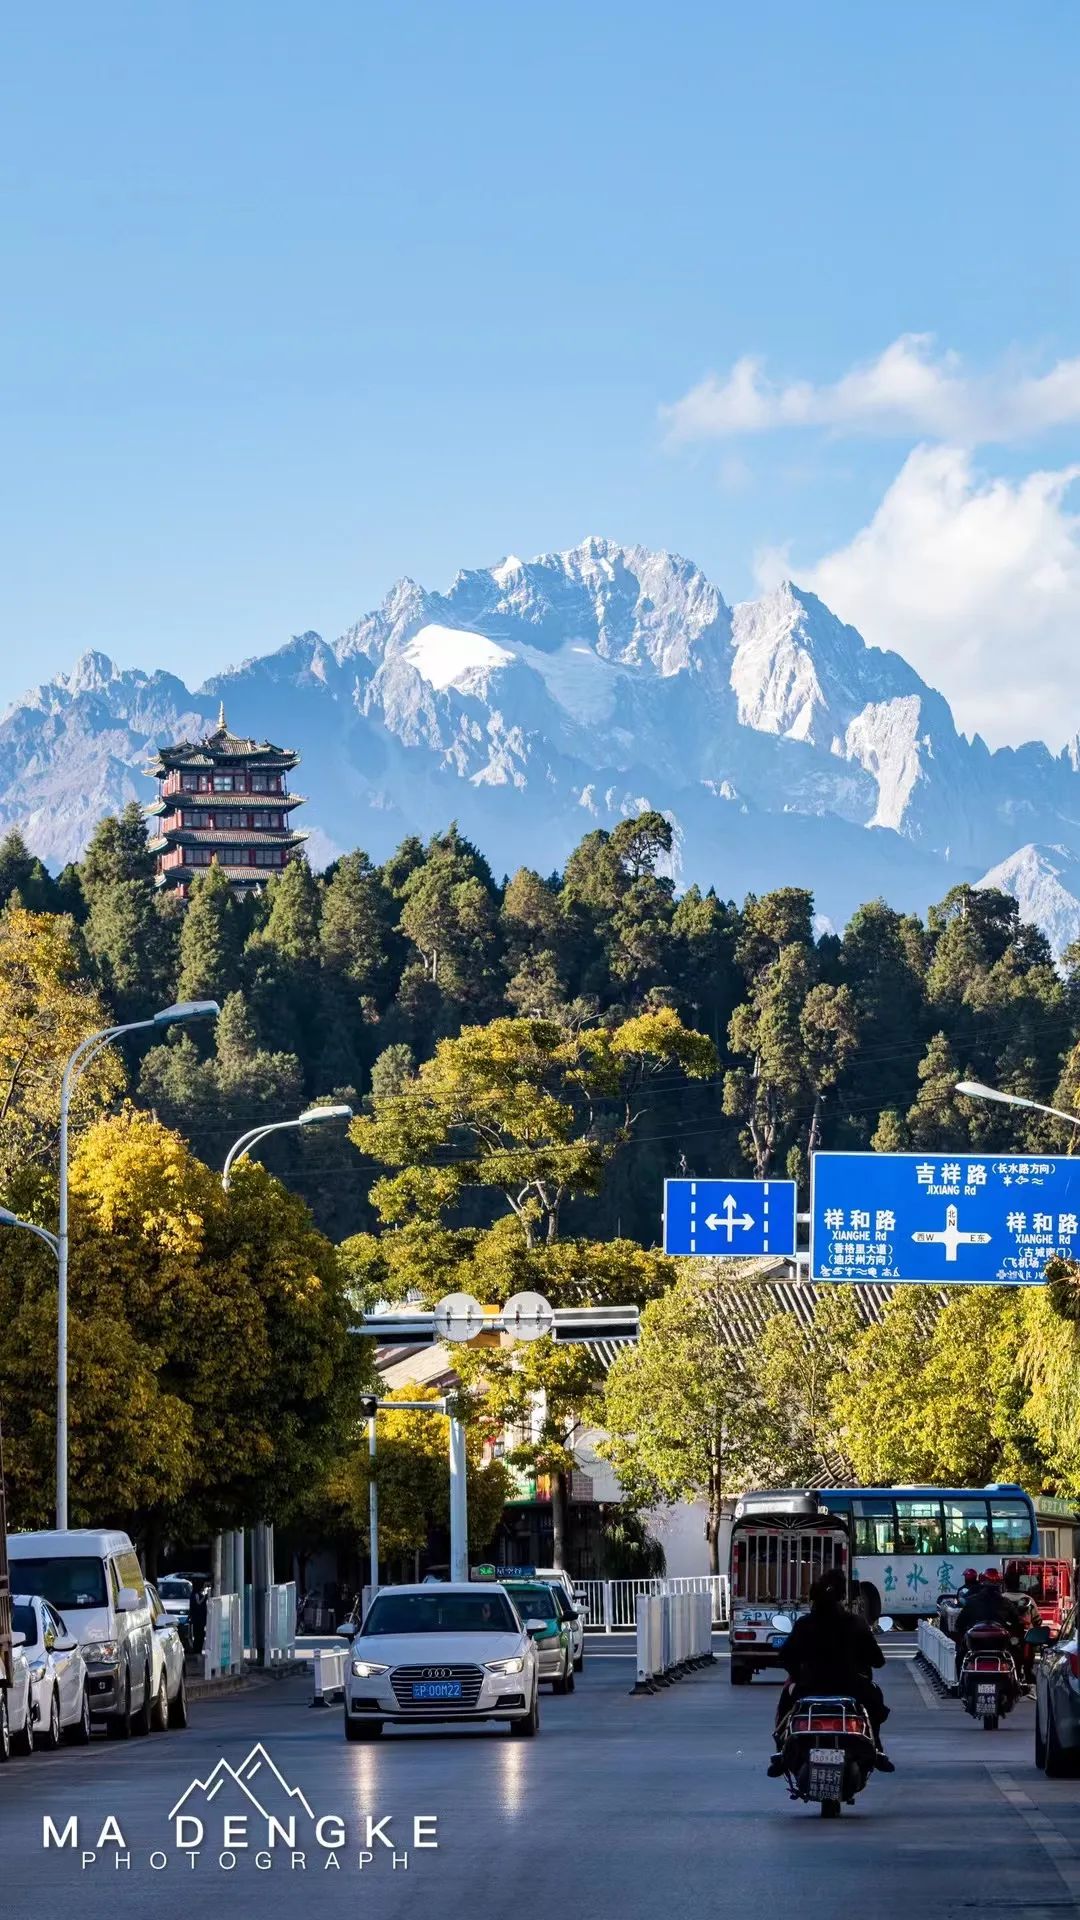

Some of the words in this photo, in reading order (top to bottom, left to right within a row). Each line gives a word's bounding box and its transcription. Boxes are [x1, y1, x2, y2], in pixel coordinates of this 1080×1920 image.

[915, 1162, 988, 1185] 吉祥路
[991, 1163, 1056, 1175] （长水路方向）
[926, 1185, 960, 1195] JIXIANG
[964, 1185, 977, 1196] Rd
[823, 1208, 897, 1231] 祥和路
[1006, 1211, 1079, 1235] 祥和路
[832, 1230, 871, 1241] XIANGHE
[875, 1231, 887, 1241] Rd
[1015, 1234, 1054, 1244] XIANGHE
[1059, 1234, 1071, 1245] Rd
[852, 1559, 958, 1592] 玉水寨
[742, 1610, 798, 1622] 云PV0
